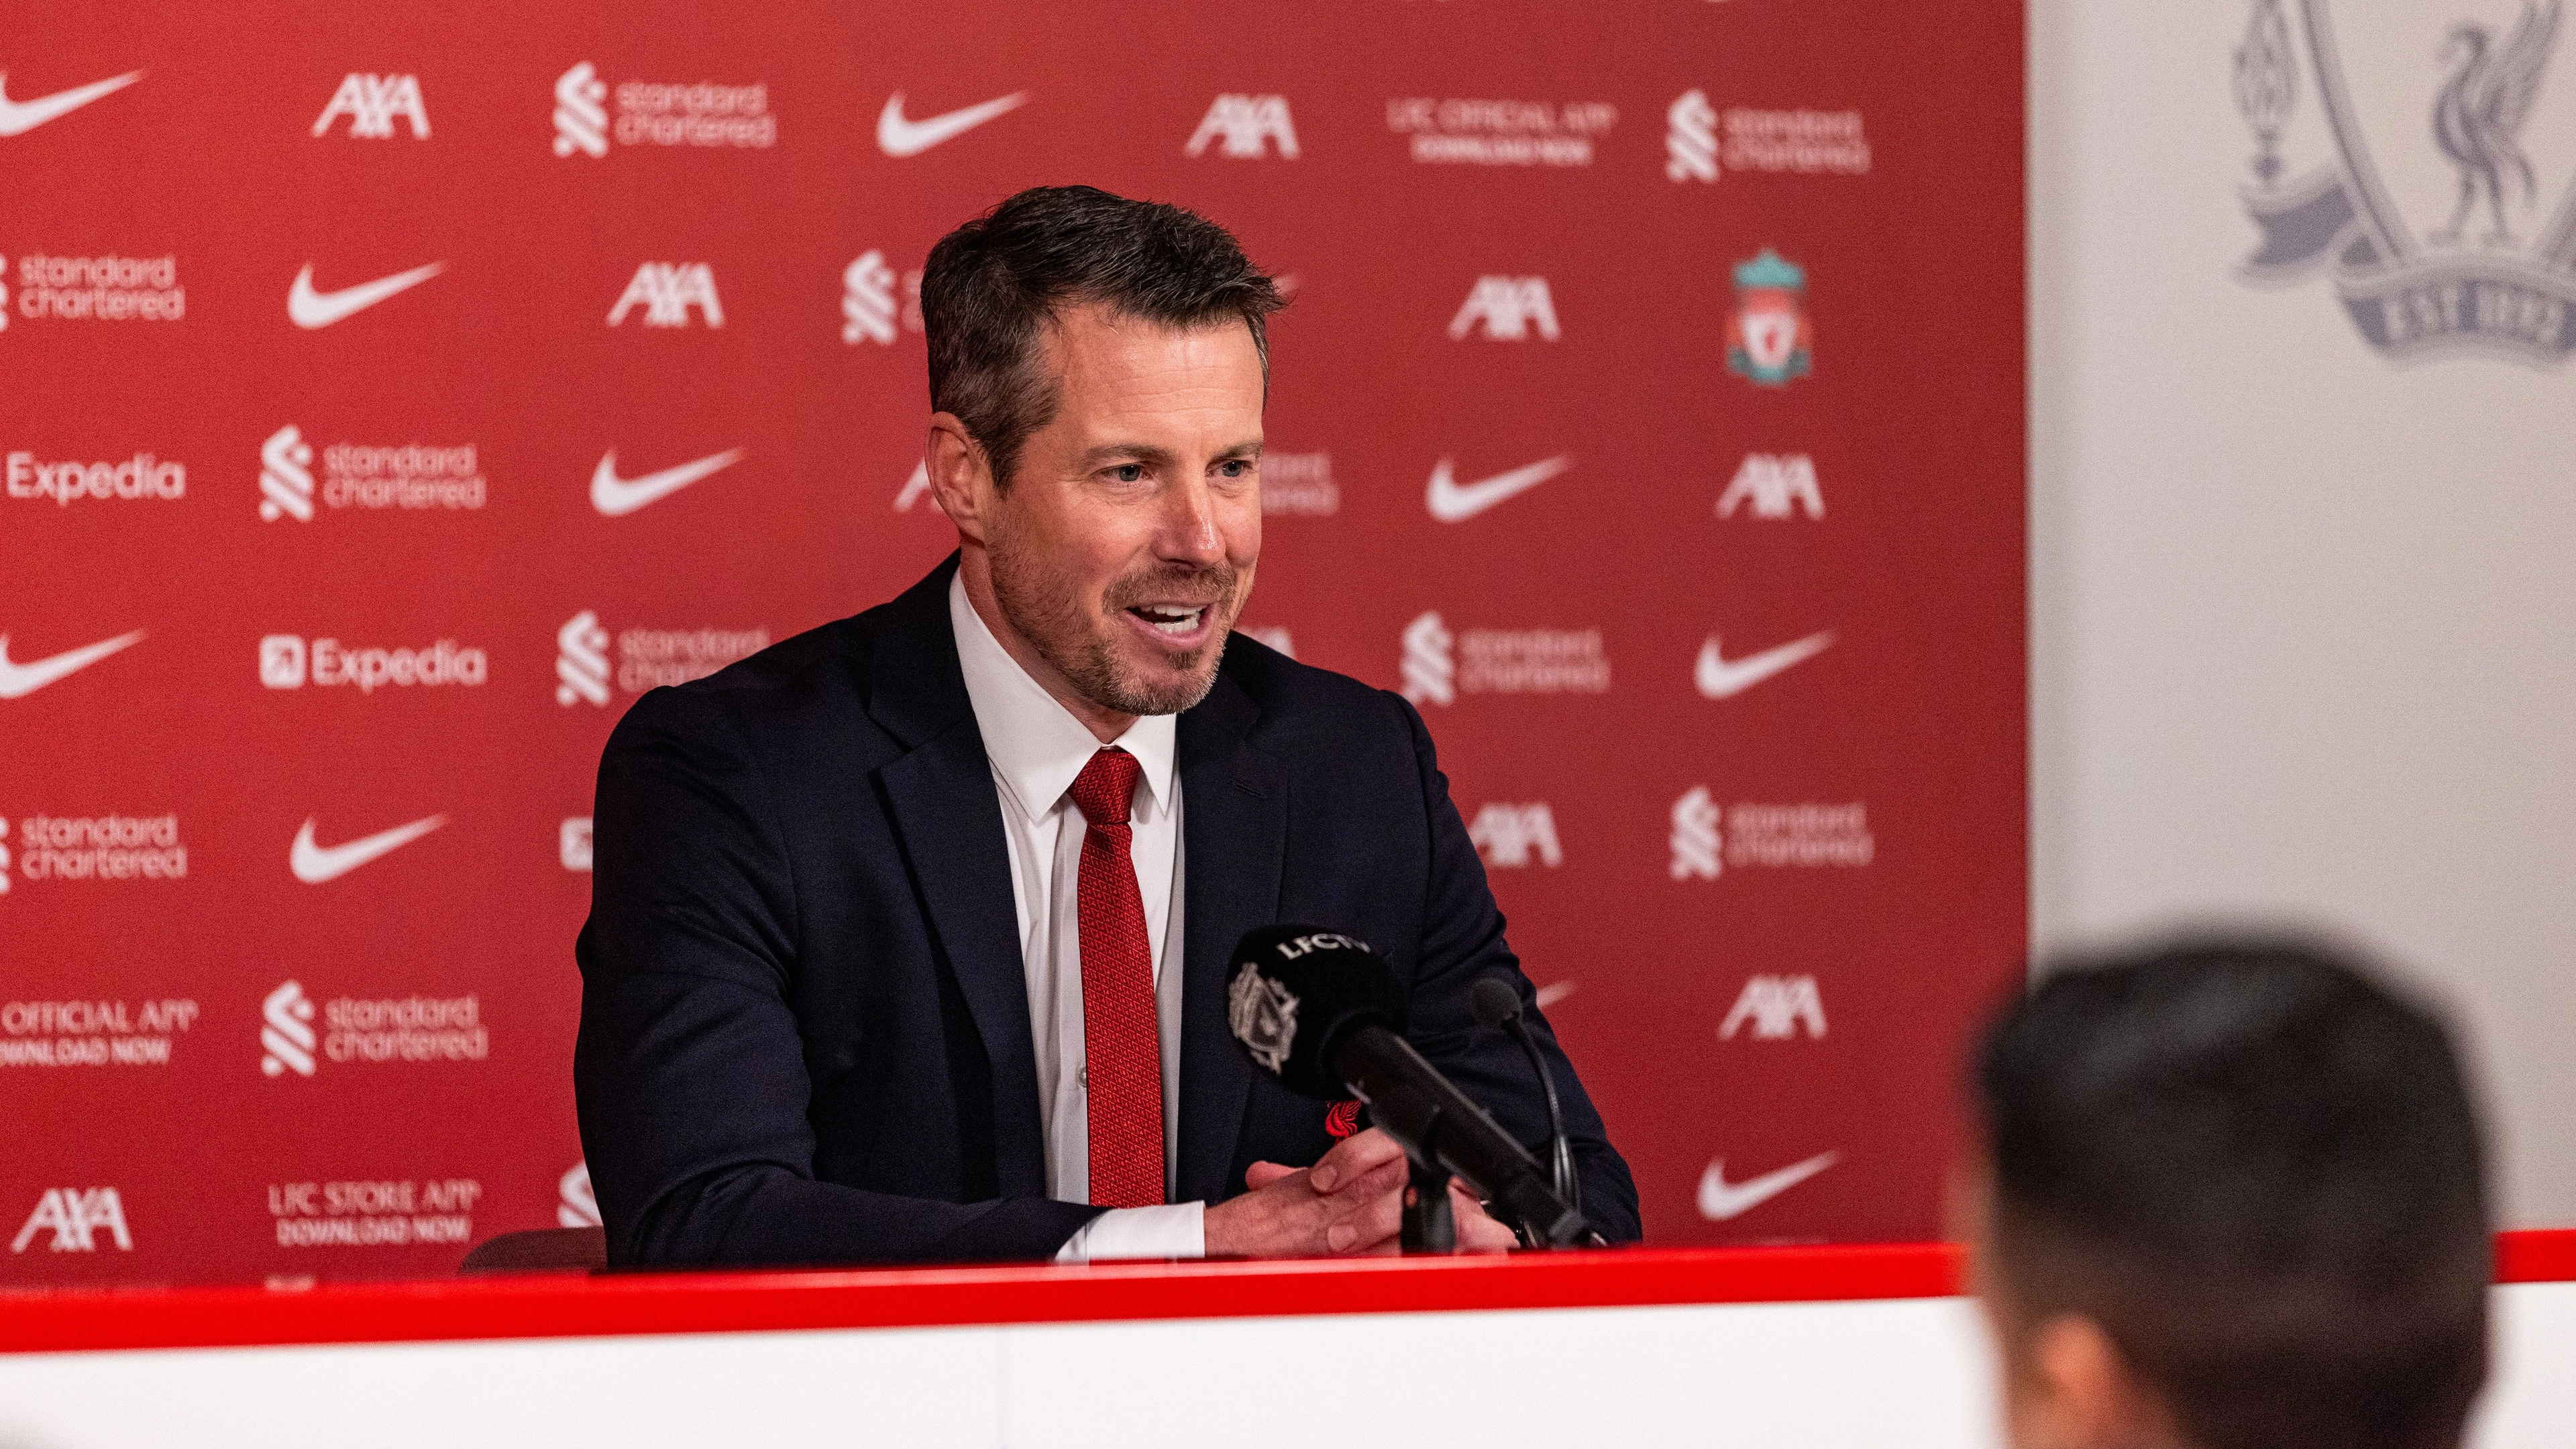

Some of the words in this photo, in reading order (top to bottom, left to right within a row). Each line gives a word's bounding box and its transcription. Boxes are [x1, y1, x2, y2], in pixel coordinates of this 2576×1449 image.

[313, 74, 429, 138] AXA
[1187, 95, 1298, 157] AXA
[19, 255, 175, 286] standard
[19, 286, 184, 320] chartered
[608, 263, 722, 326] AXA
[1451, 277, 1558, 338] AXA
[324, 444, 476, 476] standard
[7, 451, 185, 505] Expedia
[323, 476, 486, 508] chartered
[1719, 455, 1823, 517] AXA
[312, 639, 486, 692] Expedia
[21, 815, 177, 845] standard
[21, 845, 187, 879] chartered
[1, 1001, 133, 1034] OFFICIAL
[139, 1000, 199, 1031] APP
[326, 996, 480, 1029] standard
[1722, 977, 1825, 1038] AXA
[110, 1037, 170, 1063] NOW
[325, 1029, 488, 1061] chartered
[268, 1183, 317, 1216] LFC
[324, 1181, 413, 1214] STORE
[423, 1180, 481, 1210] APP
[13, 1188, 131, 1251] AXA
[277, 1217, 411, 1246] DOWNLOAD
[412, 1216, 470, 1242] NOW
